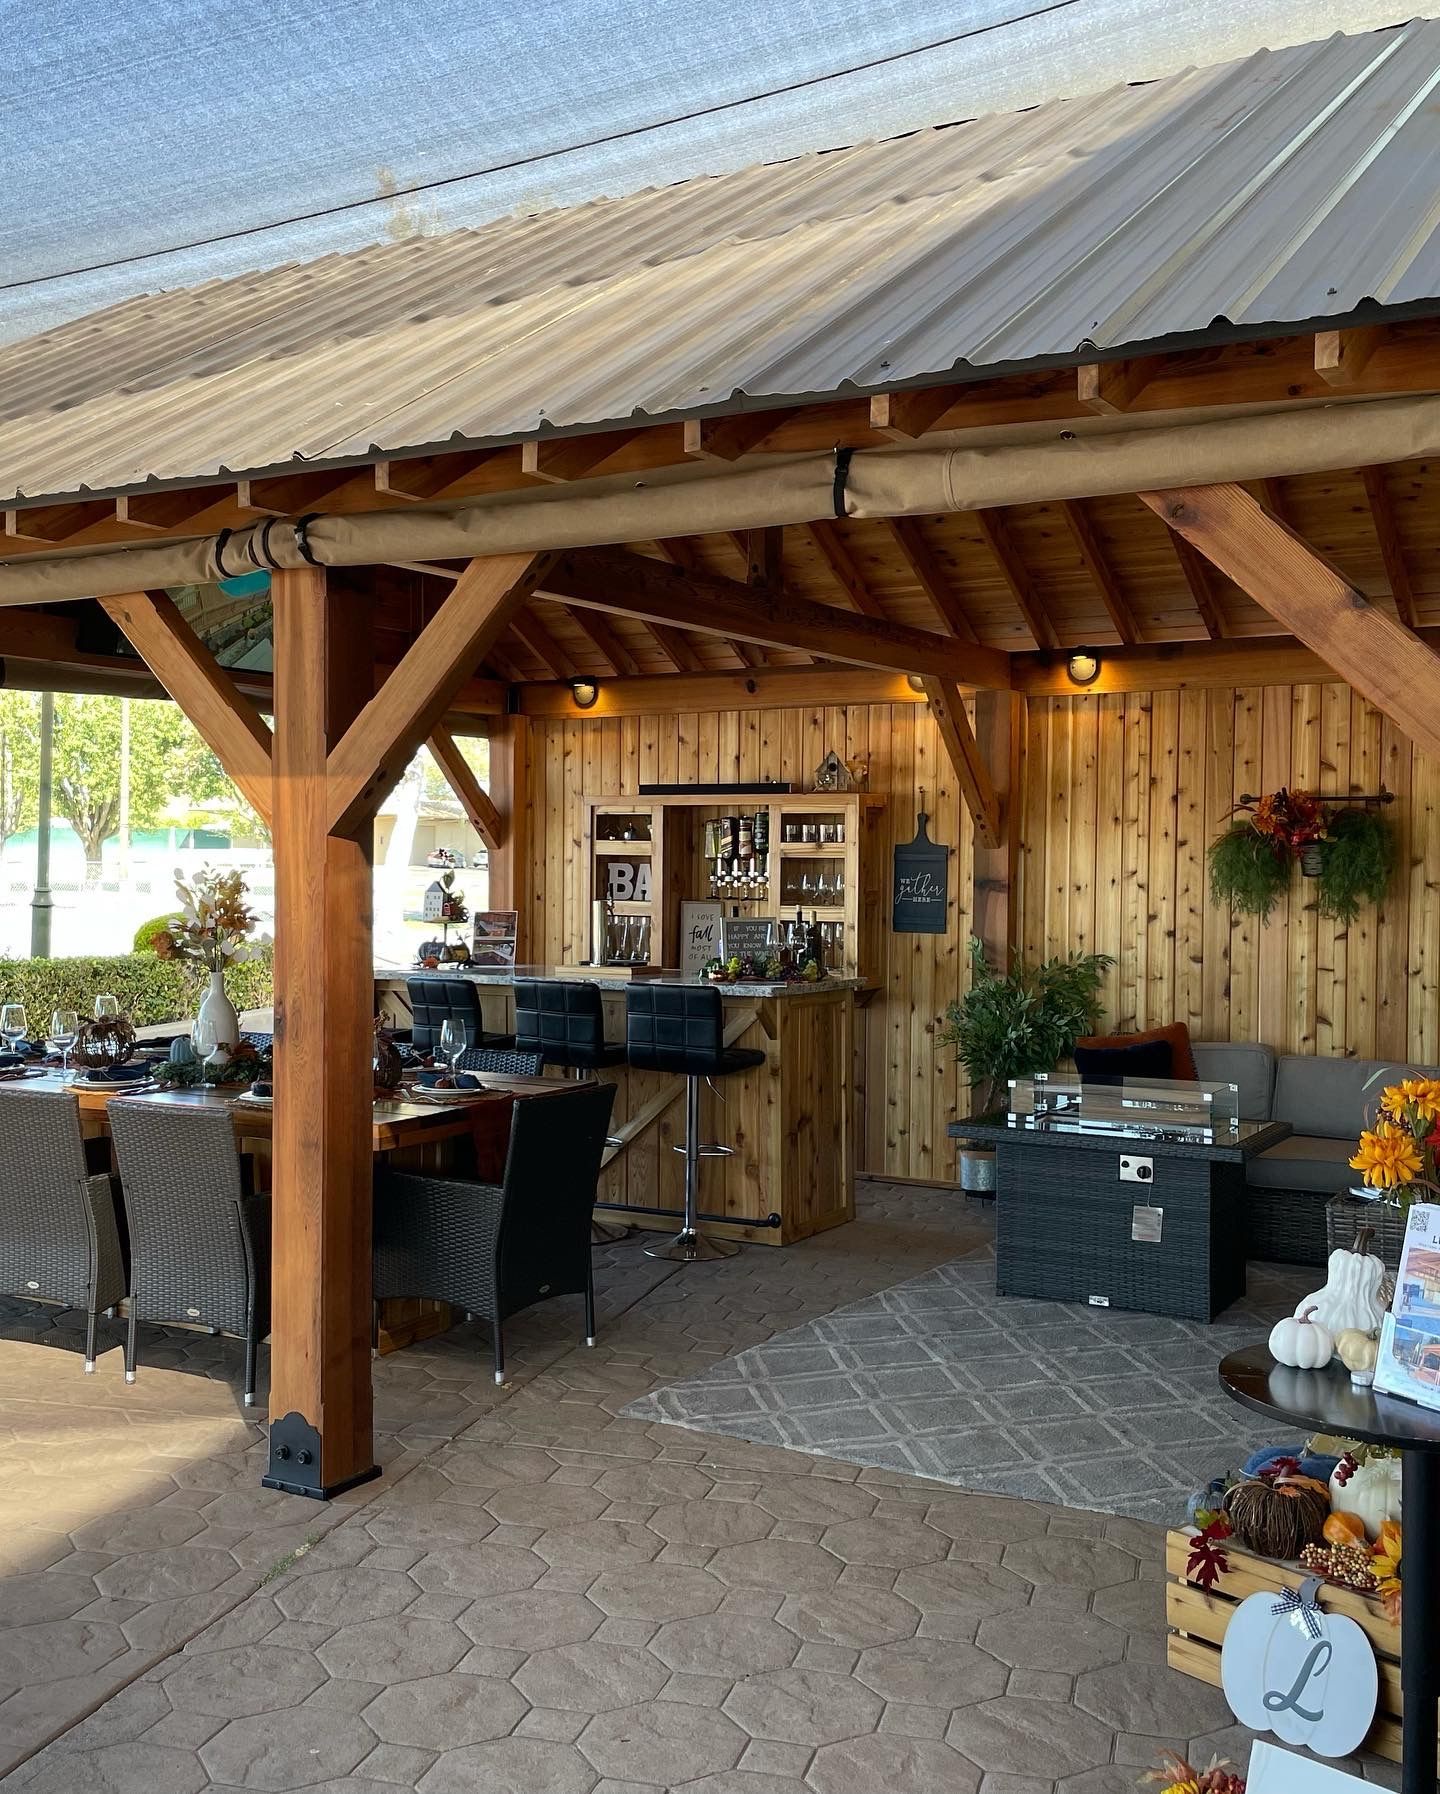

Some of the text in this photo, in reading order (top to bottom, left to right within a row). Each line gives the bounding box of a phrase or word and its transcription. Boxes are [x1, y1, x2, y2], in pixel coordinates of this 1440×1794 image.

[894, 871, 945, 904] gather
[697, 913, 715, 921] LOVE
[688, 924, 714, 943] fall
[1262, 1640, 1333, 1722] L
